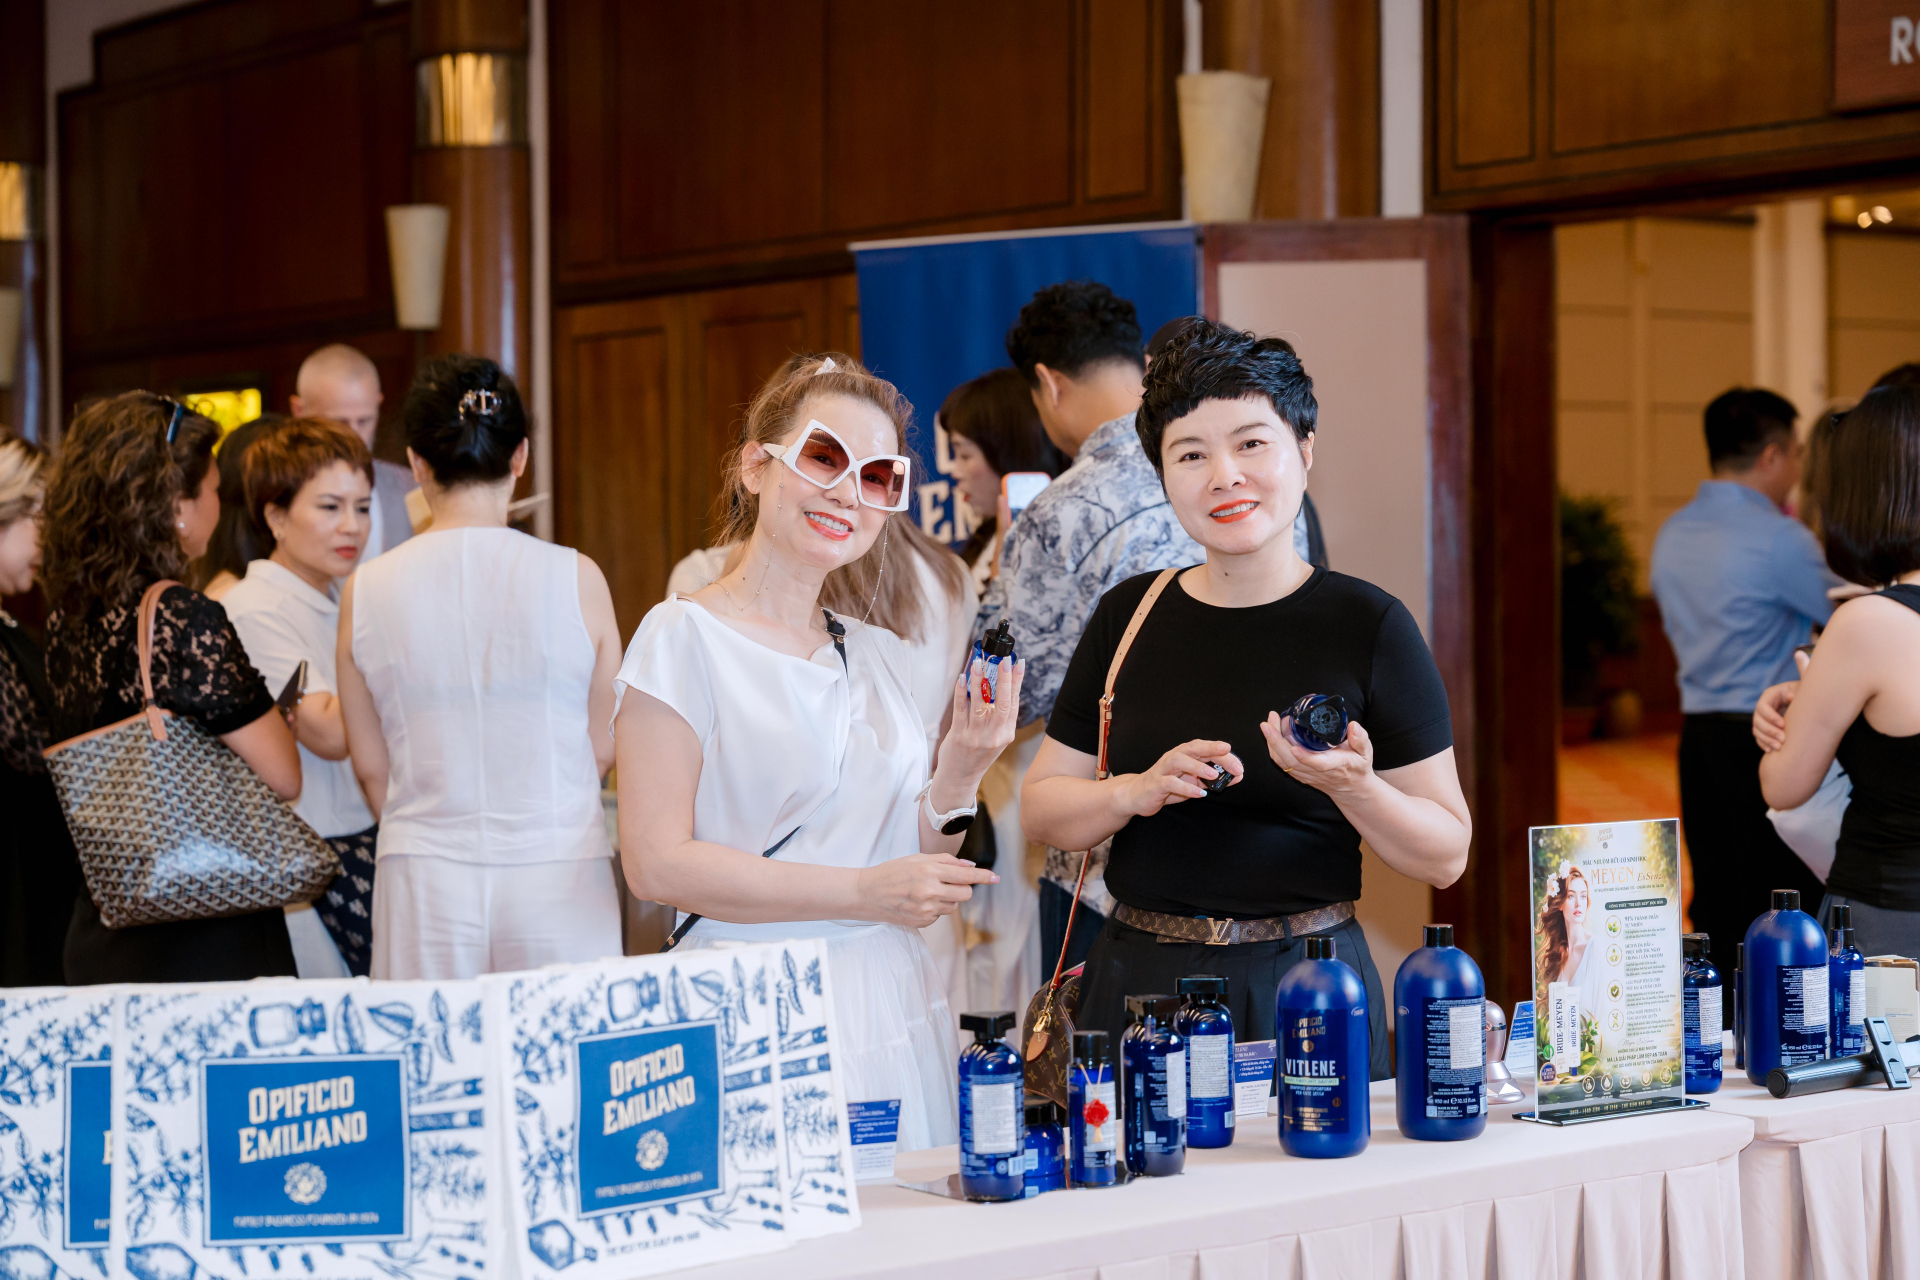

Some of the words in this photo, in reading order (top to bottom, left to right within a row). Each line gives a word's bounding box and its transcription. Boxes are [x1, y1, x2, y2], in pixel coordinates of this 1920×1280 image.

[1591, 866, 1634, 885] MEYEN
[1286, 1058, 1336, 1076] VITLENE
[1556, 1032, 1564, 1054] IRIDE
[610, 1043, 684, 1097] OPIFICIO
[248, 1075, 355, 1125] OPIFICIO
[602, 1075, 696, 1136] EMILIANO
[238, 1110, 368, 1164] EMILIANO
